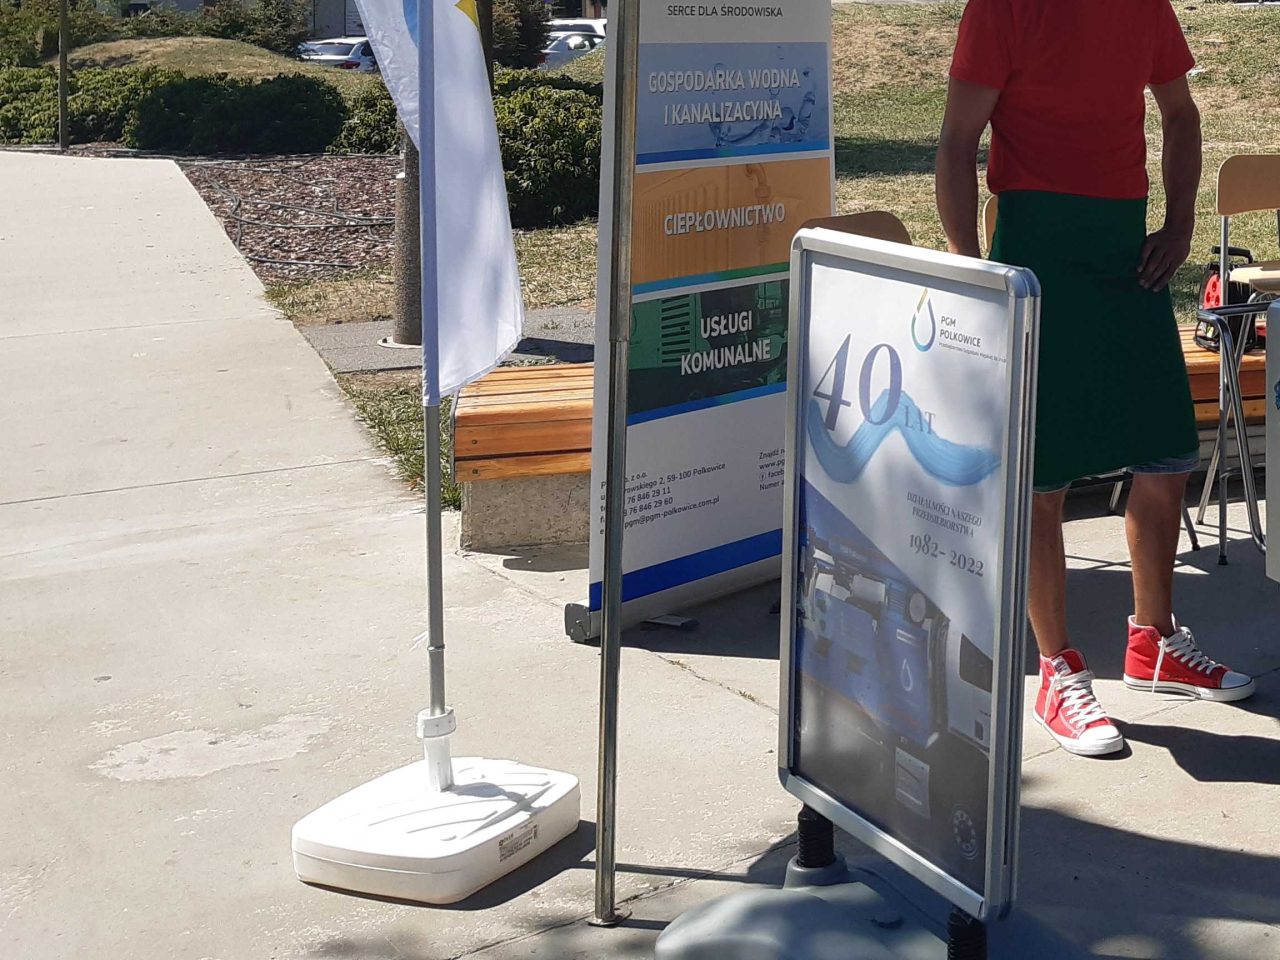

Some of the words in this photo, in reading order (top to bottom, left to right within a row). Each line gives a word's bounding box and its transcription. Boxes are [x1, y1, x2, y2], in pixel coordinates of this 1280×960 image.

[668, 5, 696, 16] SERCE
[698, 5, 718, 16] DLA
[720, 3, 783, 17] ŚRODOWISKA
[649, 70, 745, 93] GOSPODARKA
[748, 68, 801, 89] WODNA
[664, 105, 668, 125] I
[671, 100, 783, 125] KANALIZACYJNA
[664, 203, 785, 236] CIEPŁOWNICTWO
[700, 310, 753, 339] USŁUGI
[940, 315, 956, 328] PGM
[939, 329, 981, 348] POLKOWICE
[681, 338, 771, 376] KOMUNALNE
[813, 333, 903, 432] 40
[904, 405, 936, 435] LAT
[667, 470, 692, 484] 59-100
[693, 463, 726, 477] Polkowice
[652, 488, 661, 498] 29
[663, 486, 671, 496] 11
